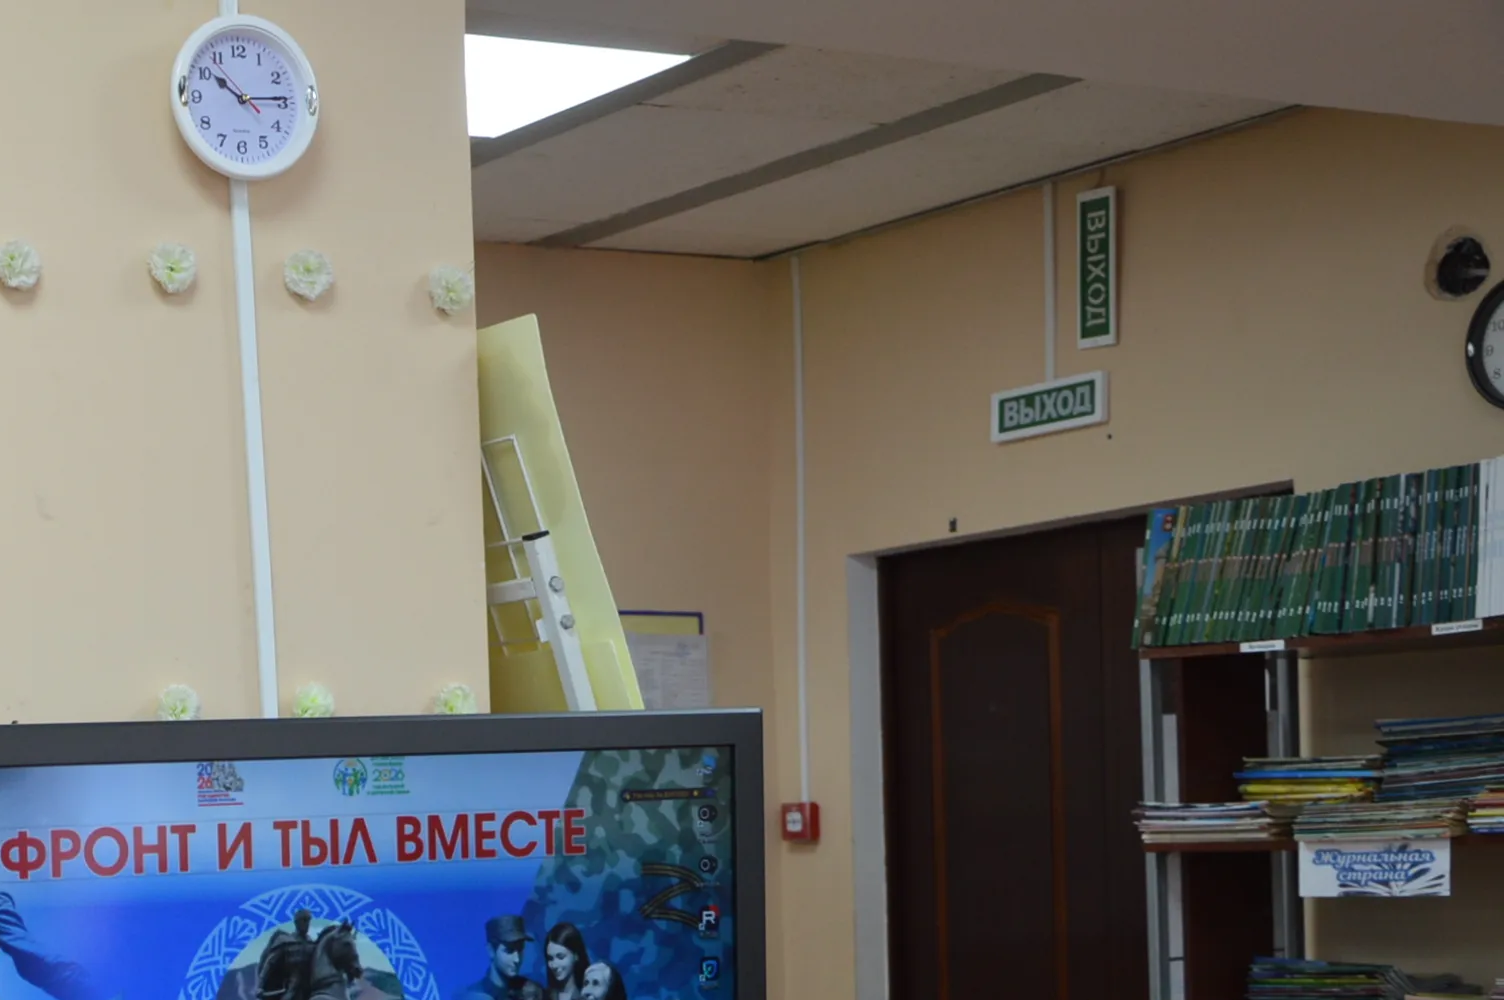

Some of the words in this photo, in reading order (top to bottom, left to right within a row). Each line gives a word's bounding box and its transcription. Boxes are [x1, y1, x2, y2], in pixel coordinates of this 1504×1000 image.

[212, 51, 223, 65] 11
[231, 45, 247, 58] 12
[256, 53, 262, 66] 1
[198, 66, 212, 81] 10
[271, 71, 282, 85] 2
[191, 89, 202, 104] 9
[277, 96, 289, 110] 3
[200, 116, 211, 130] 8
[271, 120, 282, 133] 4
[216, 133, 227, 147] 7
[258, 135, 269, 149] 5
[236, 140, 247, 155] 6
[1086, 210, 1106, 328] ВЫХОД
[1003, 384, 1092, 428] ВЫХОД
[372, 769, 406, 782] 2026
[0, 824, 197, 880] ФРОНТ
[217, 822, 253, 871] И
[273, 817, 378, 869] ТЫЛ
[396, 809, 587, 862] ВМЕСТЕ
[1314, 848, 1435, 869] Журнальная
[1338, 868, 1409, 887] страна
